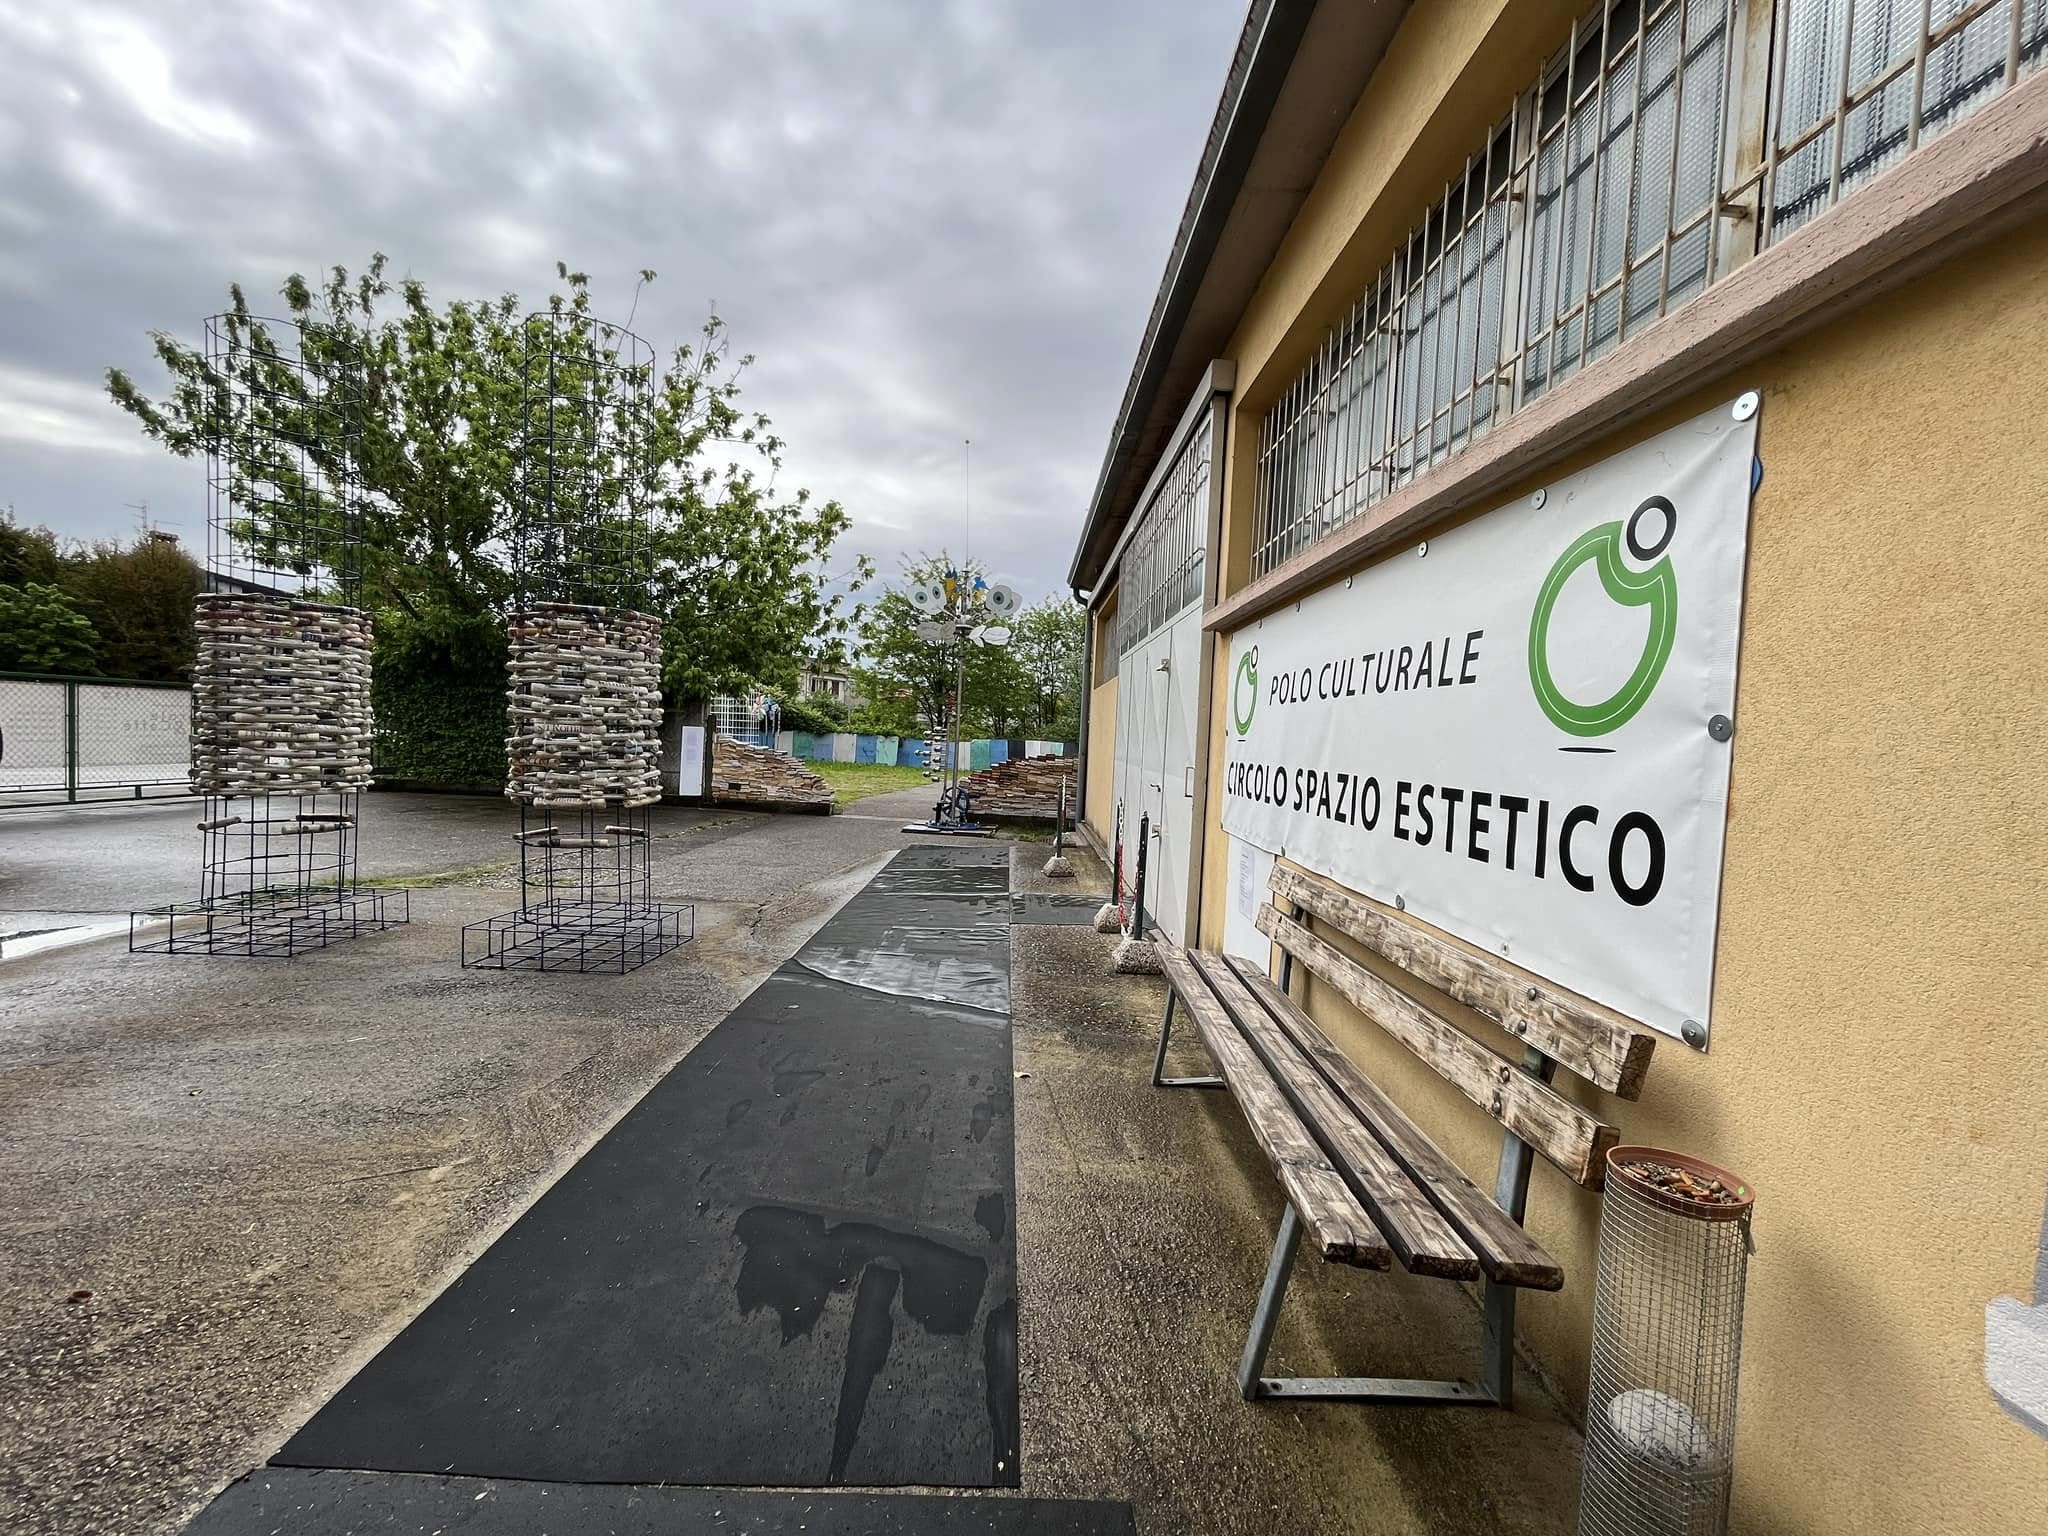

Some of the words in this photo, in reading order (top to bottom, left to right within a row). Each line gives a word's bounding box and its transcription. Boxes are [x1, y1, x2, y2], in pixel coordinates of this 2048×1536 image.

[1269, 667, 1312, 706] POLO
[1318, 629, 1484, 700] CULTURALE
[1227, 761, 1288, 808] CIRCOLO
[1293, 768, 1381, 832] SPAZIO
[1393, 780, 1666, 907] ESTETICO
